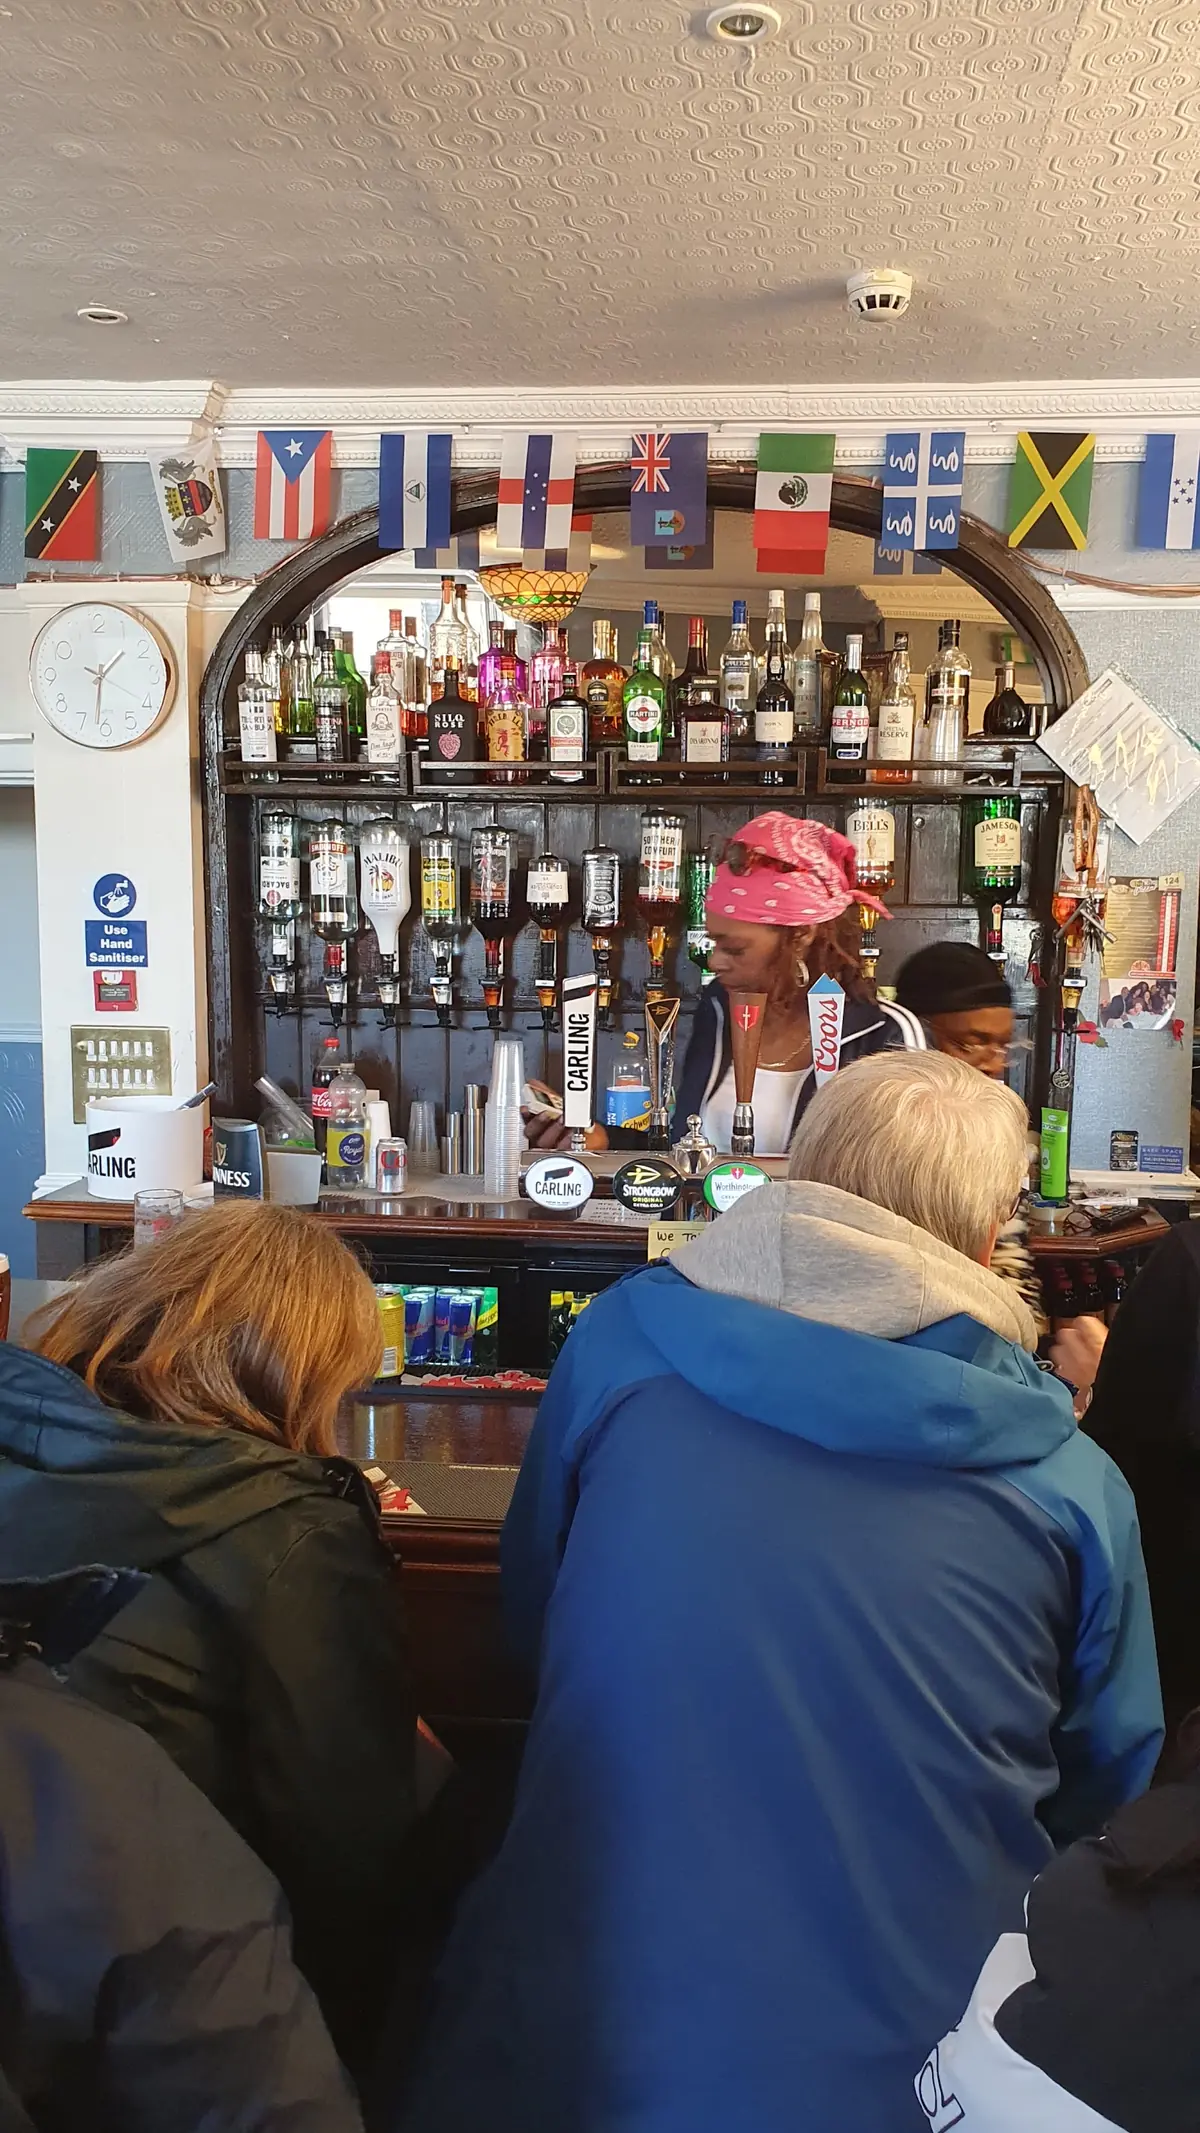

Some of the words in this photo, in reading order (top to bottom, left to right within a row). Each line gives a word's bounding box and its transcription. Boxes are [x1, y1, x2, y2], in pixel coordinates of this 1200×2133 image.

[137, 640, 149, 659] 2
[44, 667, 56, 686] 9
[149, 665, 159, 685] 3
[56, 693, 68, 712] 8
[142, 692, 152, 708] 4
[76, 712, 86, 731] 7
[125, 711, 137, 730] 5
[434, 713, 465, 722] SILQ
[488, 713, 522, 726] FIREBLL
[832, 718, 869, 727] PERNOD
[100, 718, 112, 736] 6
[853, 818, 888, 832] BELL'S
[981, 821, 1018, 833] JAMESON
[364, 852, 403, 868] MALIBU
[104, 925, 128, 935] Use
[101, 939, 132, 949] Hand
[90, 953, 145, 963] Sanitiser
[815, 997, 838, 1072] Coors
[567, 1013, 590, 1092] CARLING
[343, 1145, 364, 1155] Royal
[88, 1155, 136, 1178] ARLING
[213, 1169, 251, 1187] NNESS
[535, 1181, 582, 1196] CARLING
[623, 1185, 676, 1196] STRONGBOW
[657, 1232, 674, 1241] We
